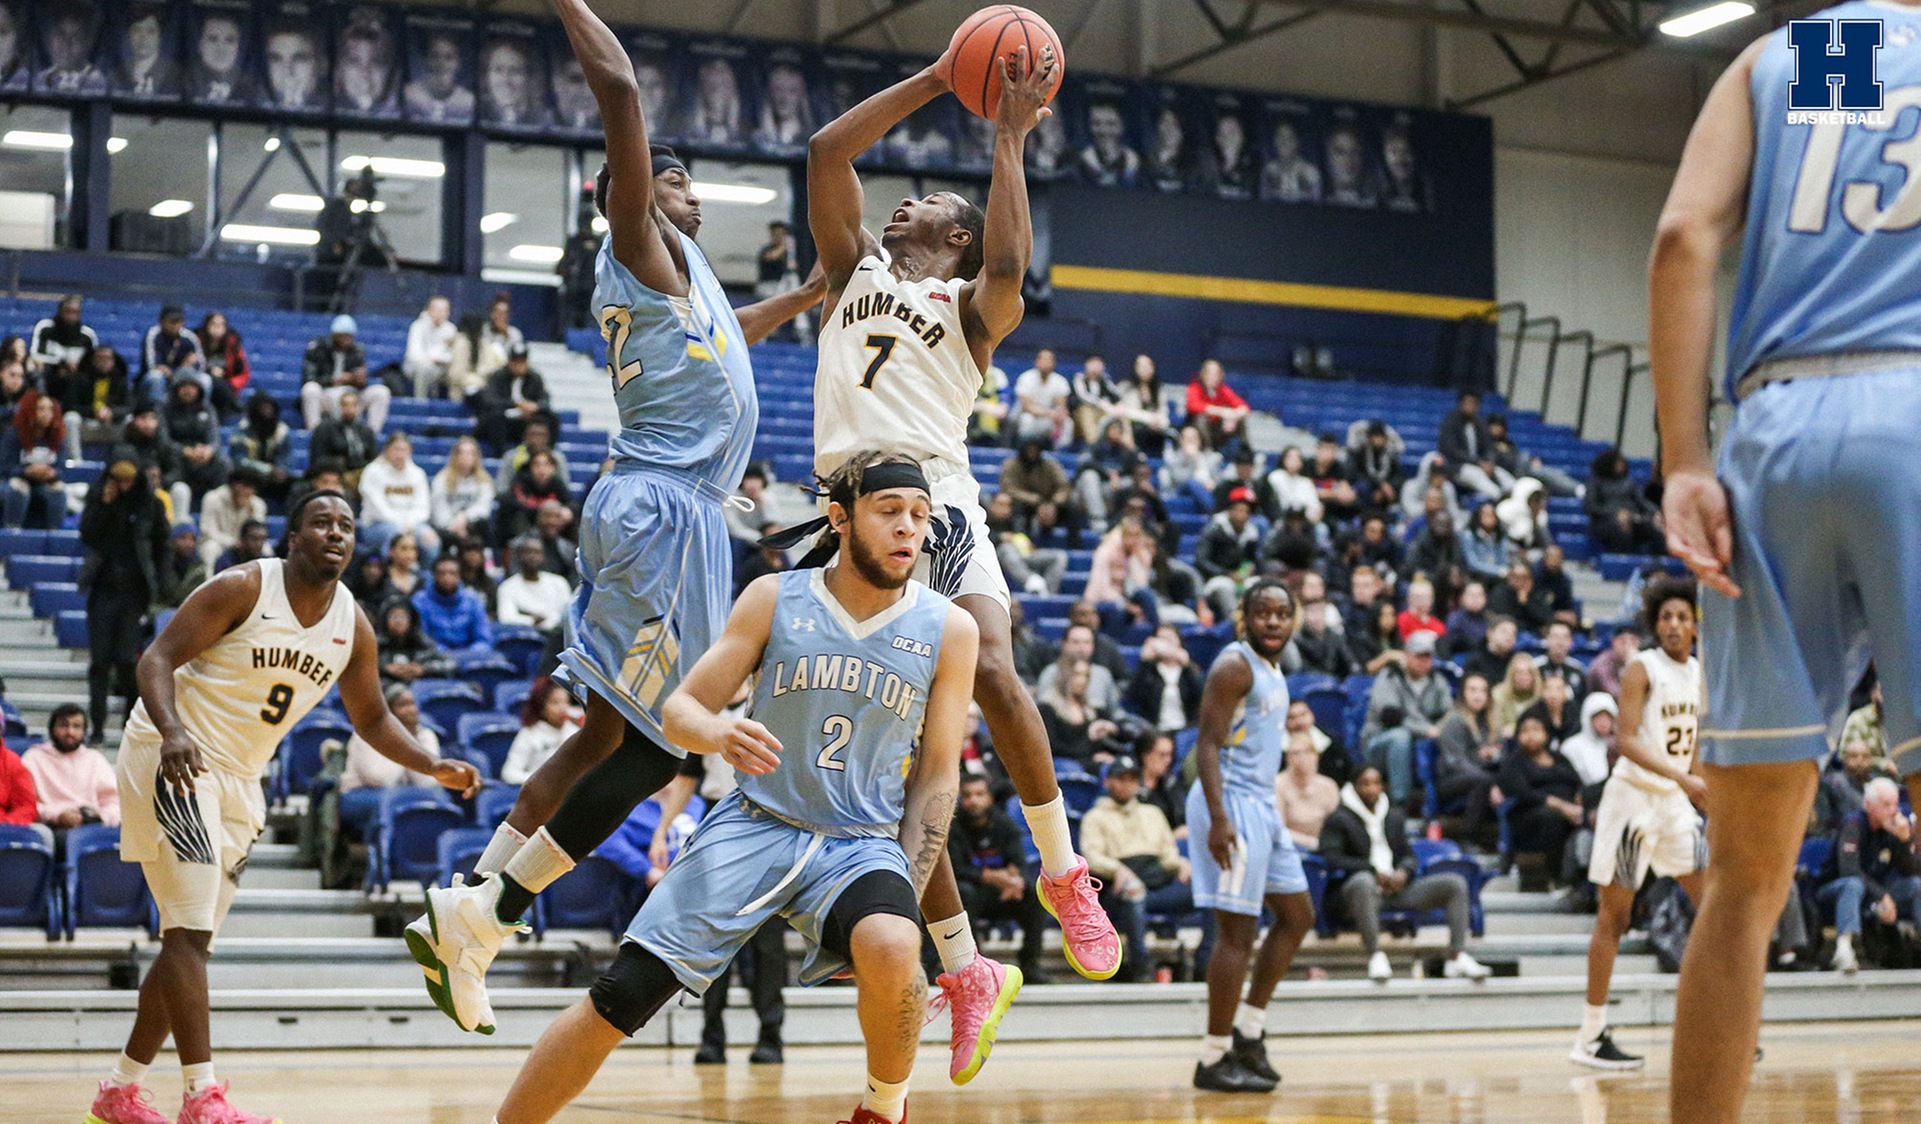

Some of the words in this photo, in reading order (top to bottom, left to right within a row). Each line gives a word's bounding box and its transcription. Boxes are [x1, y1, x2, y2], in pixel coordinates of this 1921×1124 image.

[842, 292, 946, 350] HUMBER
[857, 333, 899, 391] 7
[891, 634, 933, 659] OCAA
[260, 682, 295, 727] 9
[772, 653, 918, 722] LAMBTON
[816, 714, 854, 773] 2
